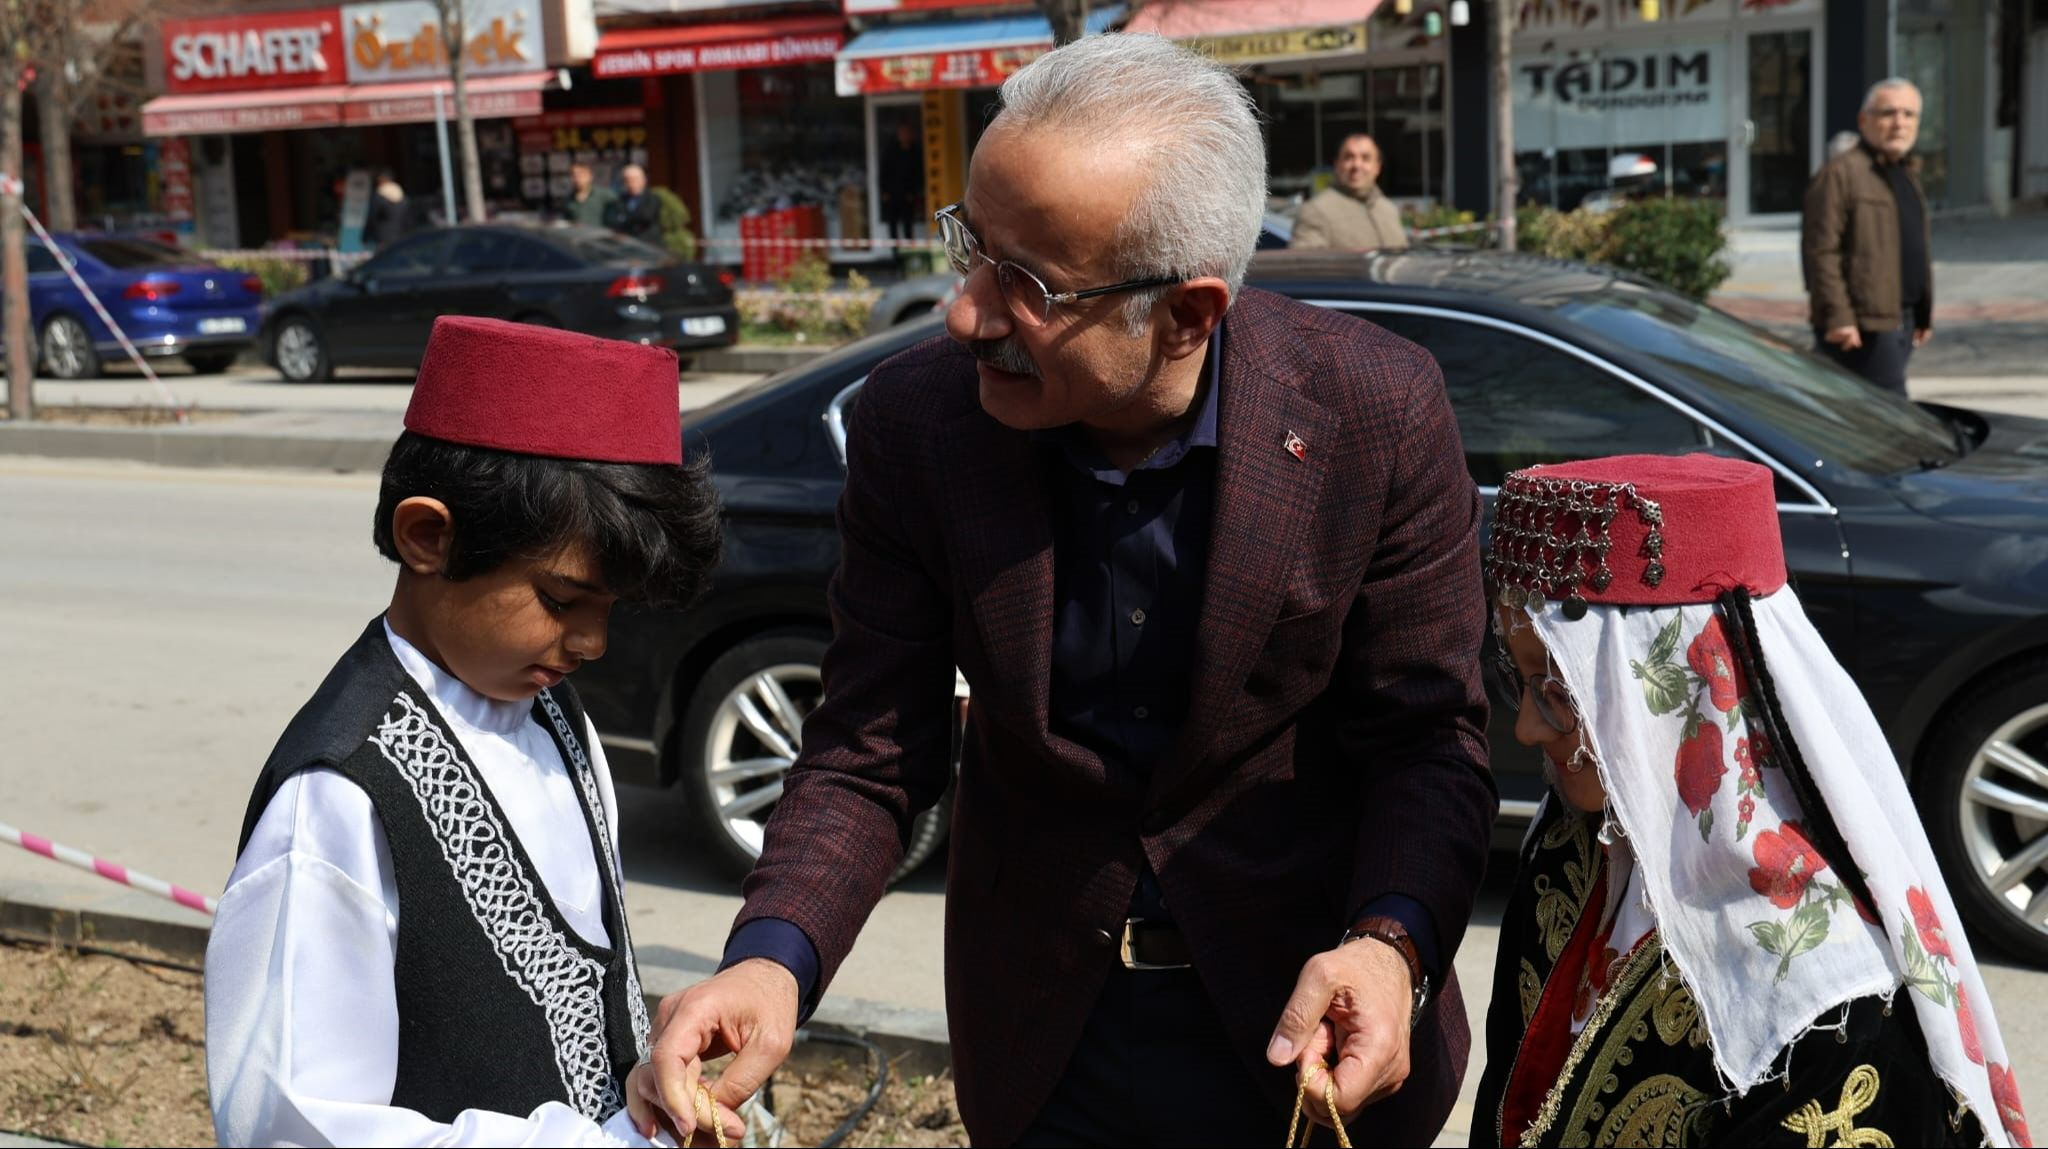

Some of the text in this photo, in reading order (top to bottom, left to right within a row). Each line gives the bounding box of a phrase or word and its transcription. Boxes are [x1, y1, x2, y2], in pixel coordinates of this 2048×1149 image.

[171, 29, 328, 81] SCHAFER
[353, 14, 528, 70] Özdiek
[1520, 51, 1710, 101] TADIM
